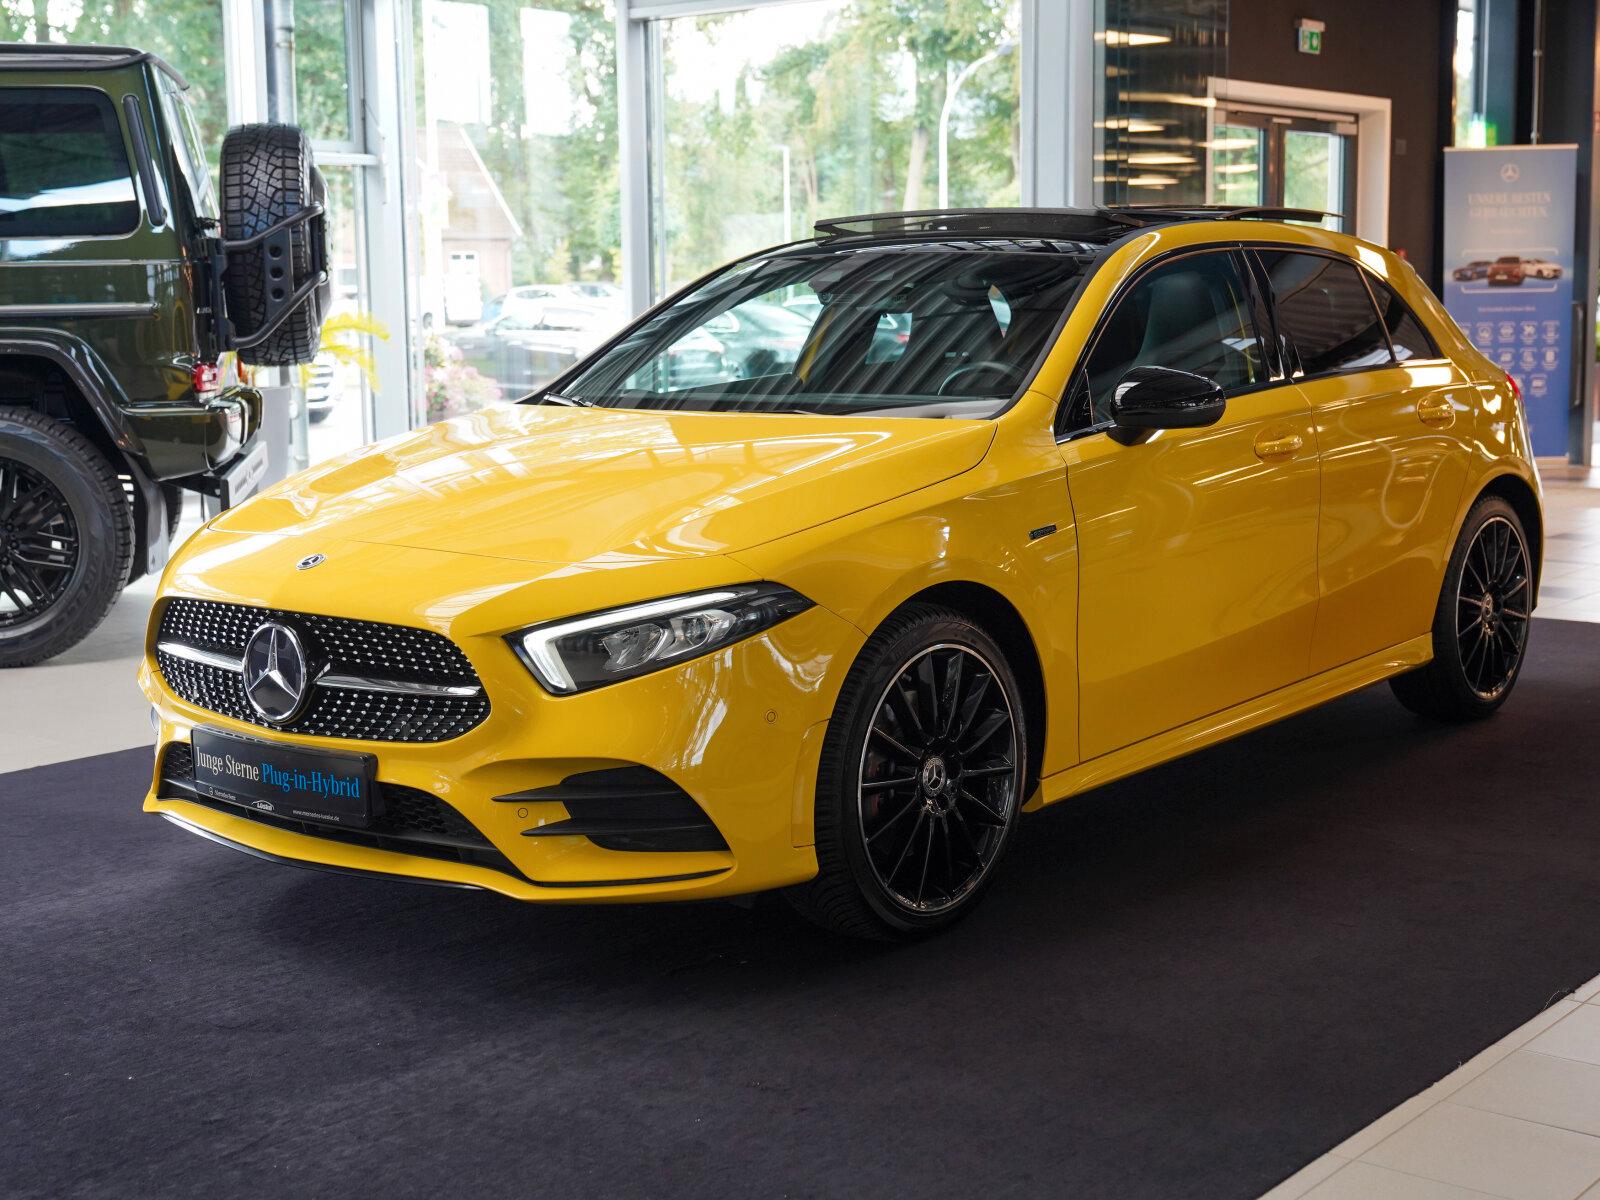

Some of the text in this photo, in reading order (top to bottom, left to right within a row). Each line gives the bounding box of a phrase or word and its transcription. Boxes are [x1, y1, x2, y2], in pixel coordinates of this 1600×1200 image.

[196, 747, 360, 798] Junge Sterne Plug-in-Hybrid
